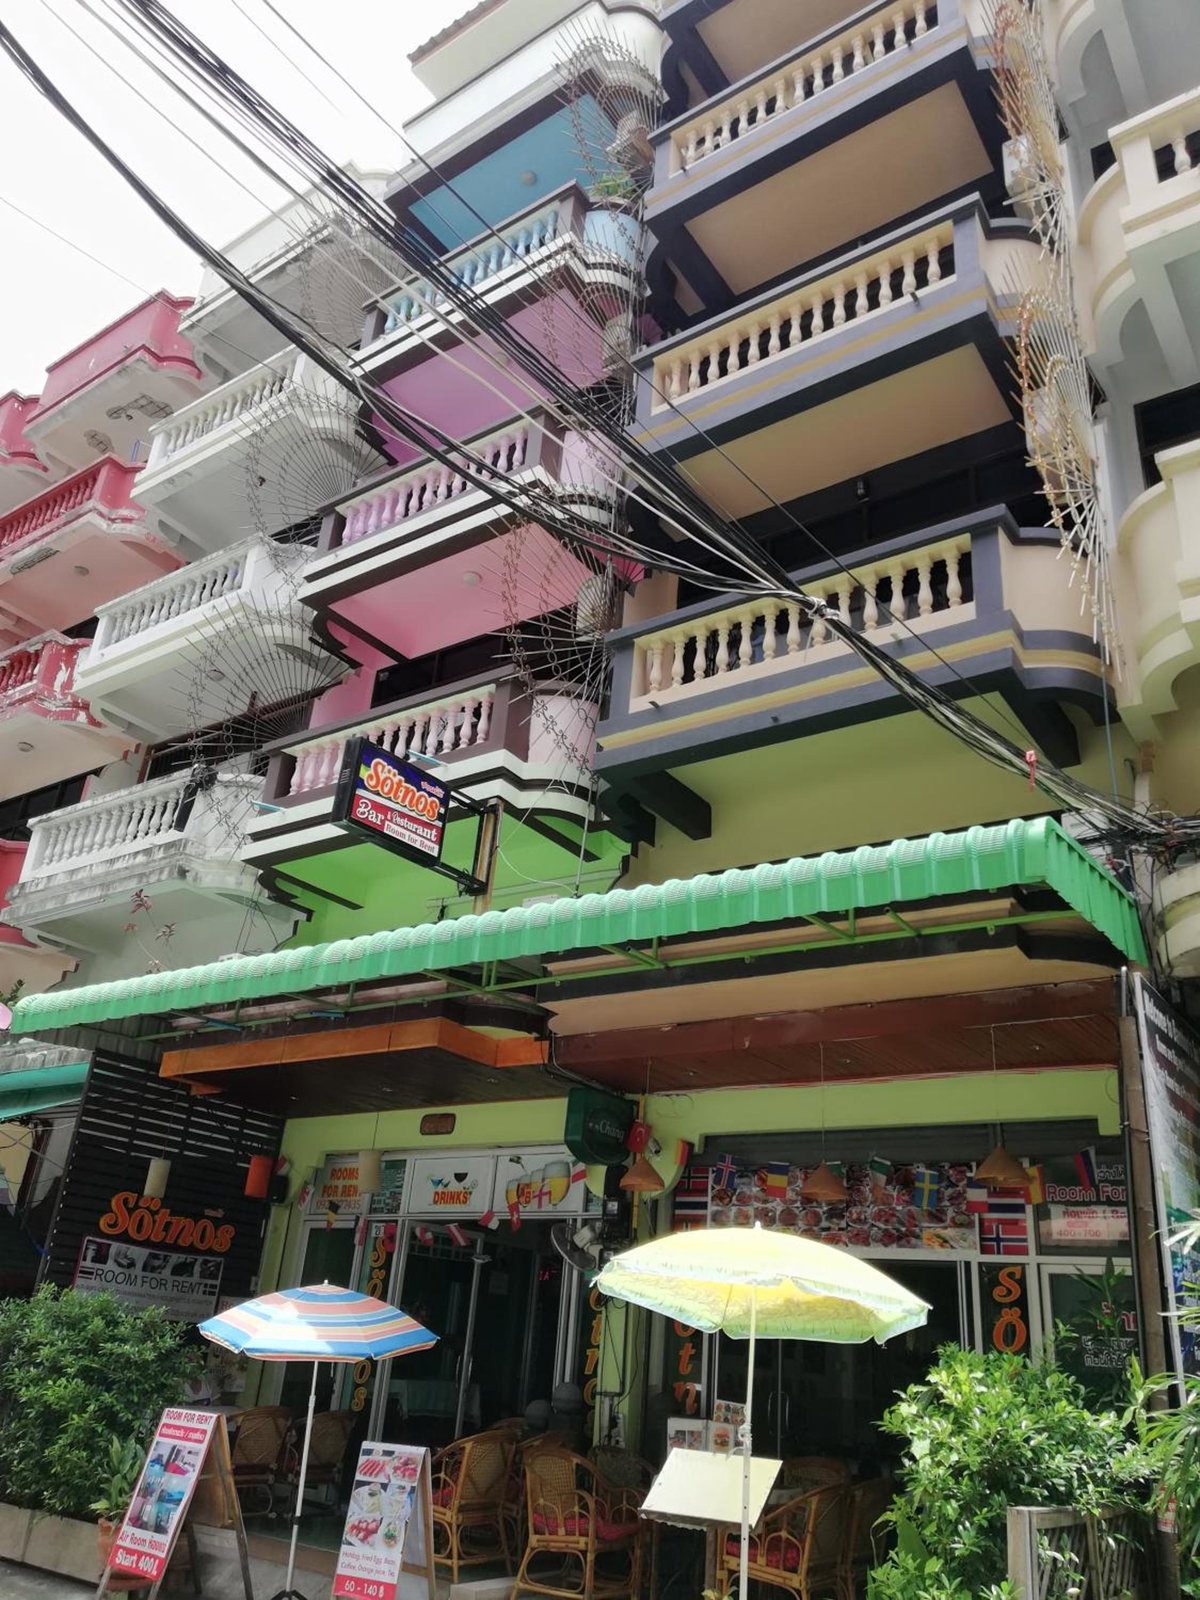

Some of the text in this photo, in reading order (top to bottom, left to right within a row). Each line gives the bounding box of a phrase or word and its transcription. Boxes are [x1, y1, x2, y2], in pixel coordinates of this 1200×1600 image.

[364, 758, 440, 821] Sötnos
[356, 799, 385, 825] Bar
[386, 823, 436, 854] Room for Rent
[323, 1184, 359, 1198] FOR REN
[433, 1190, 469, 1205] DRINKS
[1046, 1183, 1127, 1202] Room For
[99, 1191, 236, 1253] Sötnos
[94, 1269, 203, 1295] ROOM FOR RENT
[165, 1409, 213, 1425] ROOM FOR RENT
[119, 1530, 130, 1543] Air
[130, 1533, 148, 1547] Room
[115, 1549, 138, 1568] Start
[344, 1579, 355, 1592] 60
[364, 1583, 378, 1596] 140
